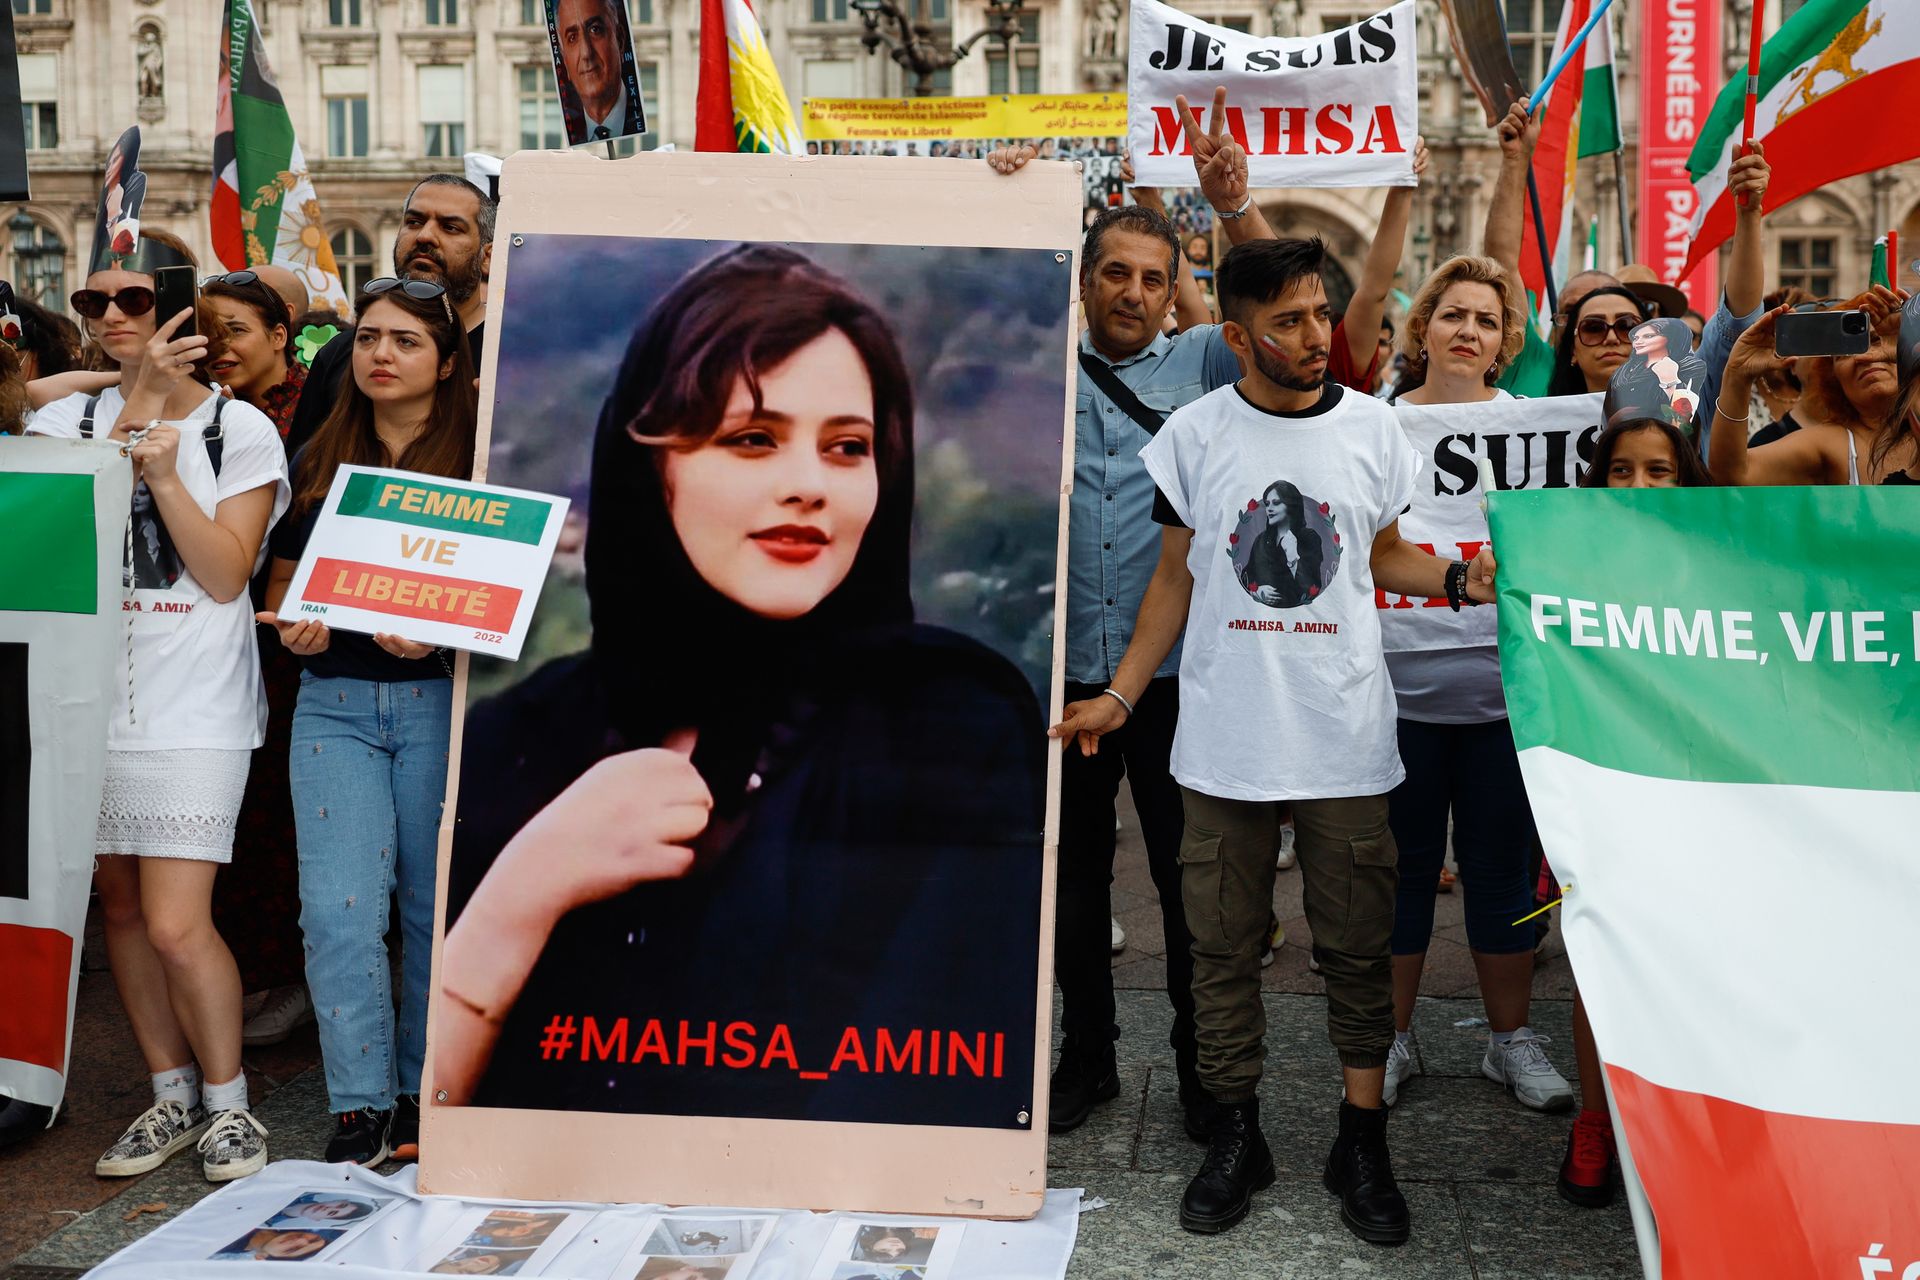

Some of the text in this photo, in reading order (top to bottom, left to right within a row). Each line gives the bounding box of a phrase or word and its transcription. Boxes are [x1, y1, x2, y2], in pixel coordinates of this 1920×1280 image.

[549, 22, 561, 65] REZA
[1149, 12, 1396, 72] JE SUIS
[624, 52, 642, 130] IN EXILE
[809, 99, 987, 111] Un petit exemple des victimes
[809, 110, 988, 122] du régime terroriste islamique
[847, 125, 953, 137] Femme Vie Liberté
[378, 483, 511, 527] FEMME
[400, 533, 460, 566] VIE
[300, 603, 328, 615] IRAN
[332, 569, 492, 618] LIBERTÉ
[473, 631, 503, 645] 2022
[1227, 619, 1339, 635] #MAHSA_AMINI
[1530, 593, 1769, 665] FEMME,
[1778, 610, 1900, 667] VIE,
[539, 1014, 1005, 1080] #MAHSA_AMINI
